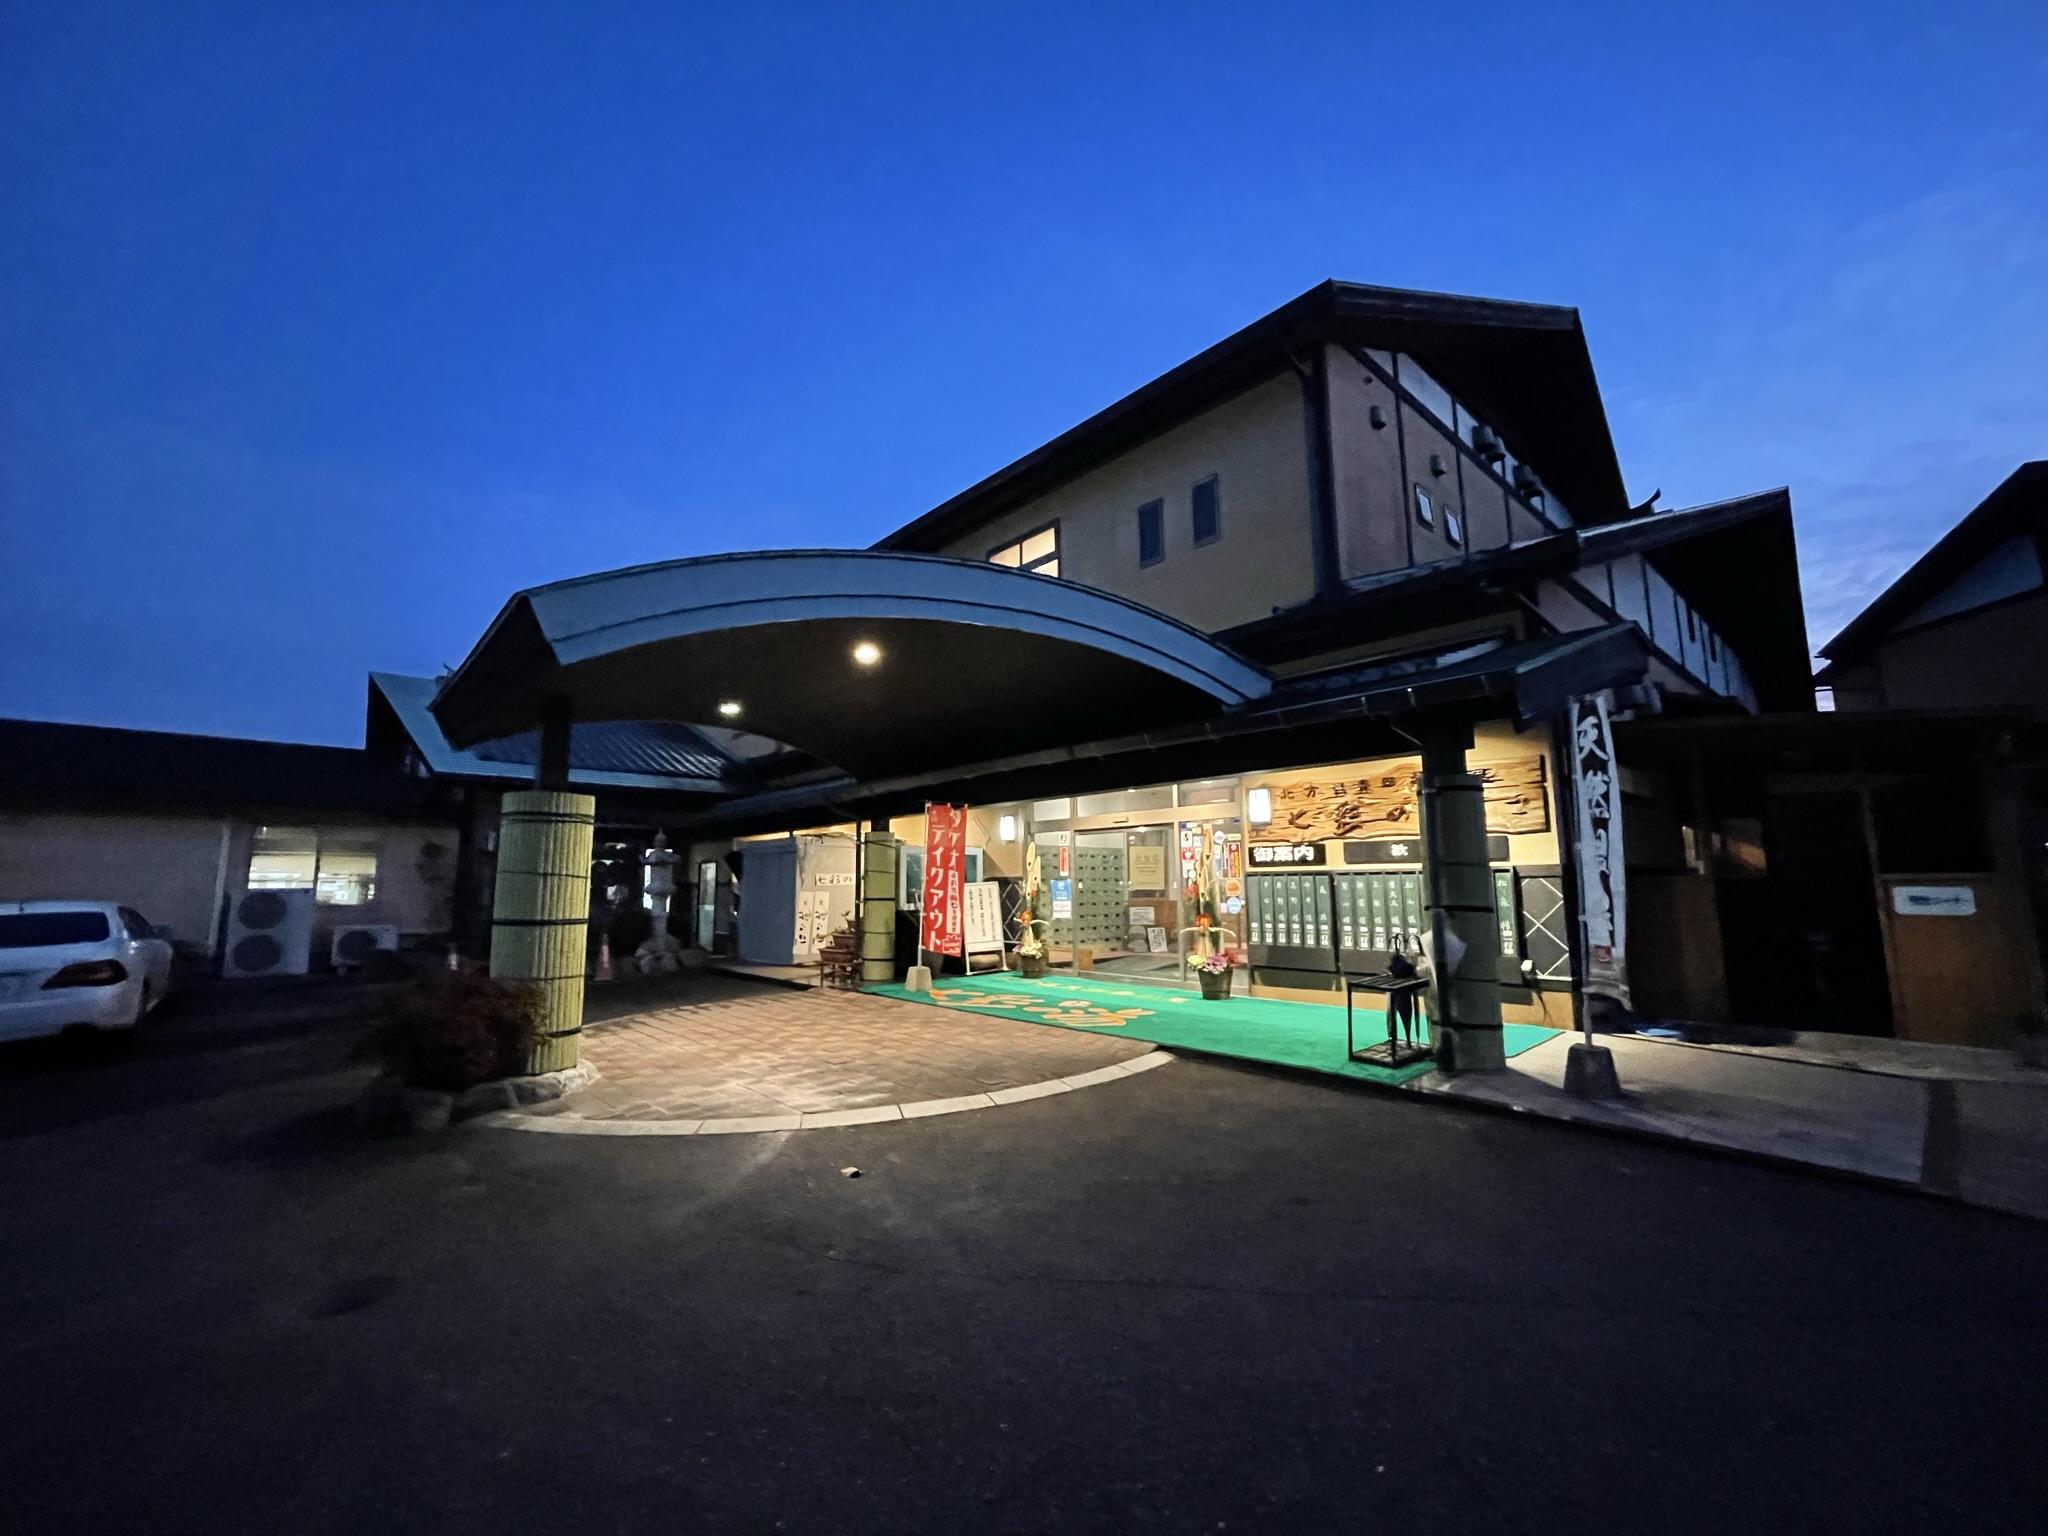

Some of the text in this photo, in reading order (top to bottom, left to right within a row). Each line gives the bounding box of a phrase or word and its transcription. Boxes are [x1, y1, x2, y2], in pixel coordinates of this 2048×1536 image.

[928, 824, 946, 952] テイクアウト
[1253, 845, 1315, 863] 御案内
